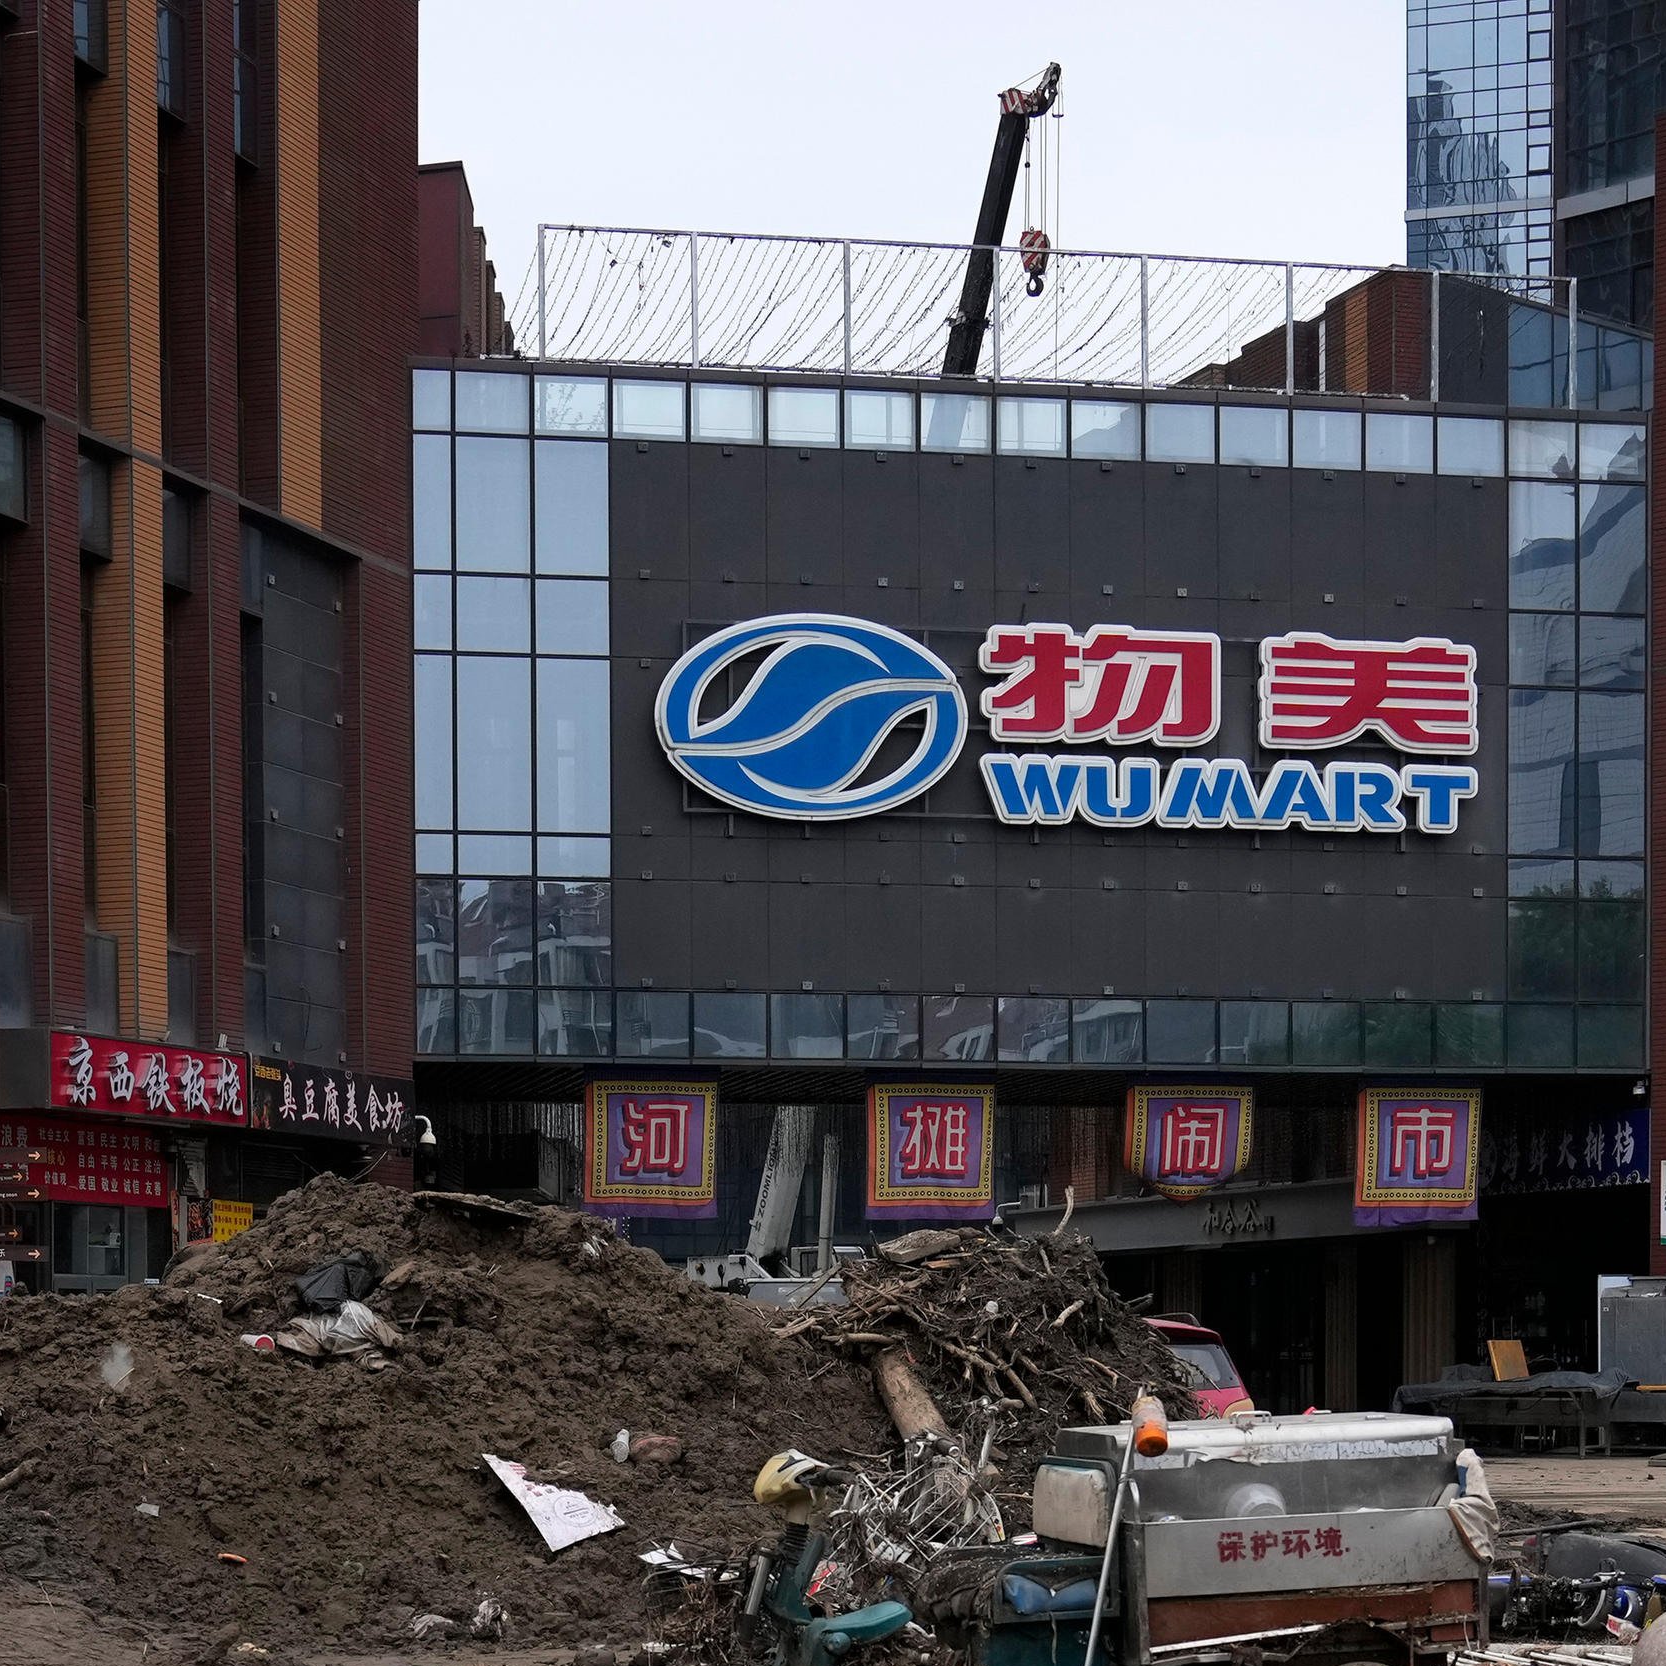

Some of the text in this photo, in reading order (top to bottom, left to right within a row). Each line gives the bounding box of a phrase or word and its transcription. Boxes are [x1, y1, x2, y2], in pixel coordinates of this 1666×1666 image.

[981, 626, 1476, 752] 物美
[983, 756, 1475, 830] WUMART
[68, 1035, 244, 1117] 京西铁板烧
[278, 1072, 406, 1134] 臭豆腐美食坊
[1, 1124, 30, 1148] 浪费
[39, 1127, 70, 1143] 社会主义
[46, 1148, 66, 1166] 核心
[77, 1129, 96, 1147] 富强
[100, 1132, 118, 1149] 民主
[123, 1134, 140, 1150] 文明
[78, 1153, 161, 1175] 自由 平等 公正 法治
[624, 1101, 690, 1171] 河
[903, 1103, 968, 1172] 摊
[1162, 1105, 1226, 1173] 闹
[1390, 1105, 1454, 1173] 市
[44, 1171, 67, 1187] 价值观
[78, 1175, 162, 1197] 爱国 敬业 诚信 友善
